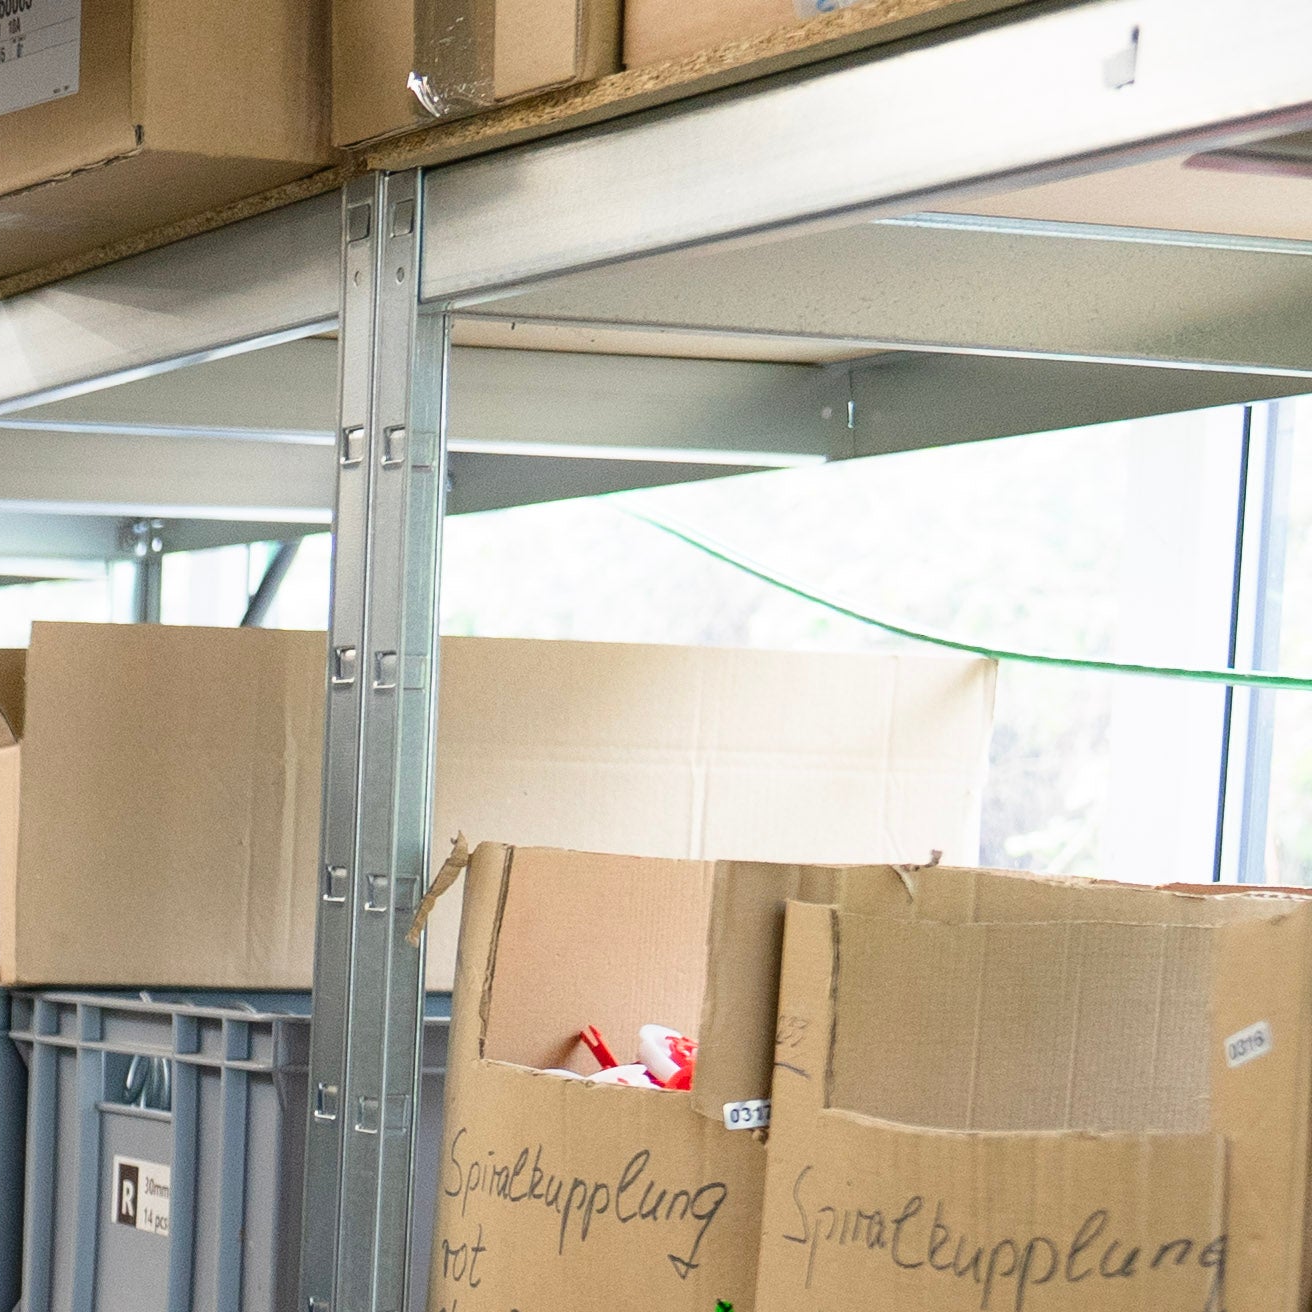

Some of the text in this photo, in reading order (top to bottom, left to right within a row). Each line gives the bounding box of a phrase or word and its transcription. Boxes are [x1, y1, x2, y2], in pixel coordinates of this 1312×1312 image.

[121, 1178, 135, 1217] R
[144, 1176, 170, 1199] 30mm
[444, 1127, 728, 1280] Spiralkupplung
[144, 1207, 169, 1234] 14 pcs
[442, 1223, 487, 1288] rot
